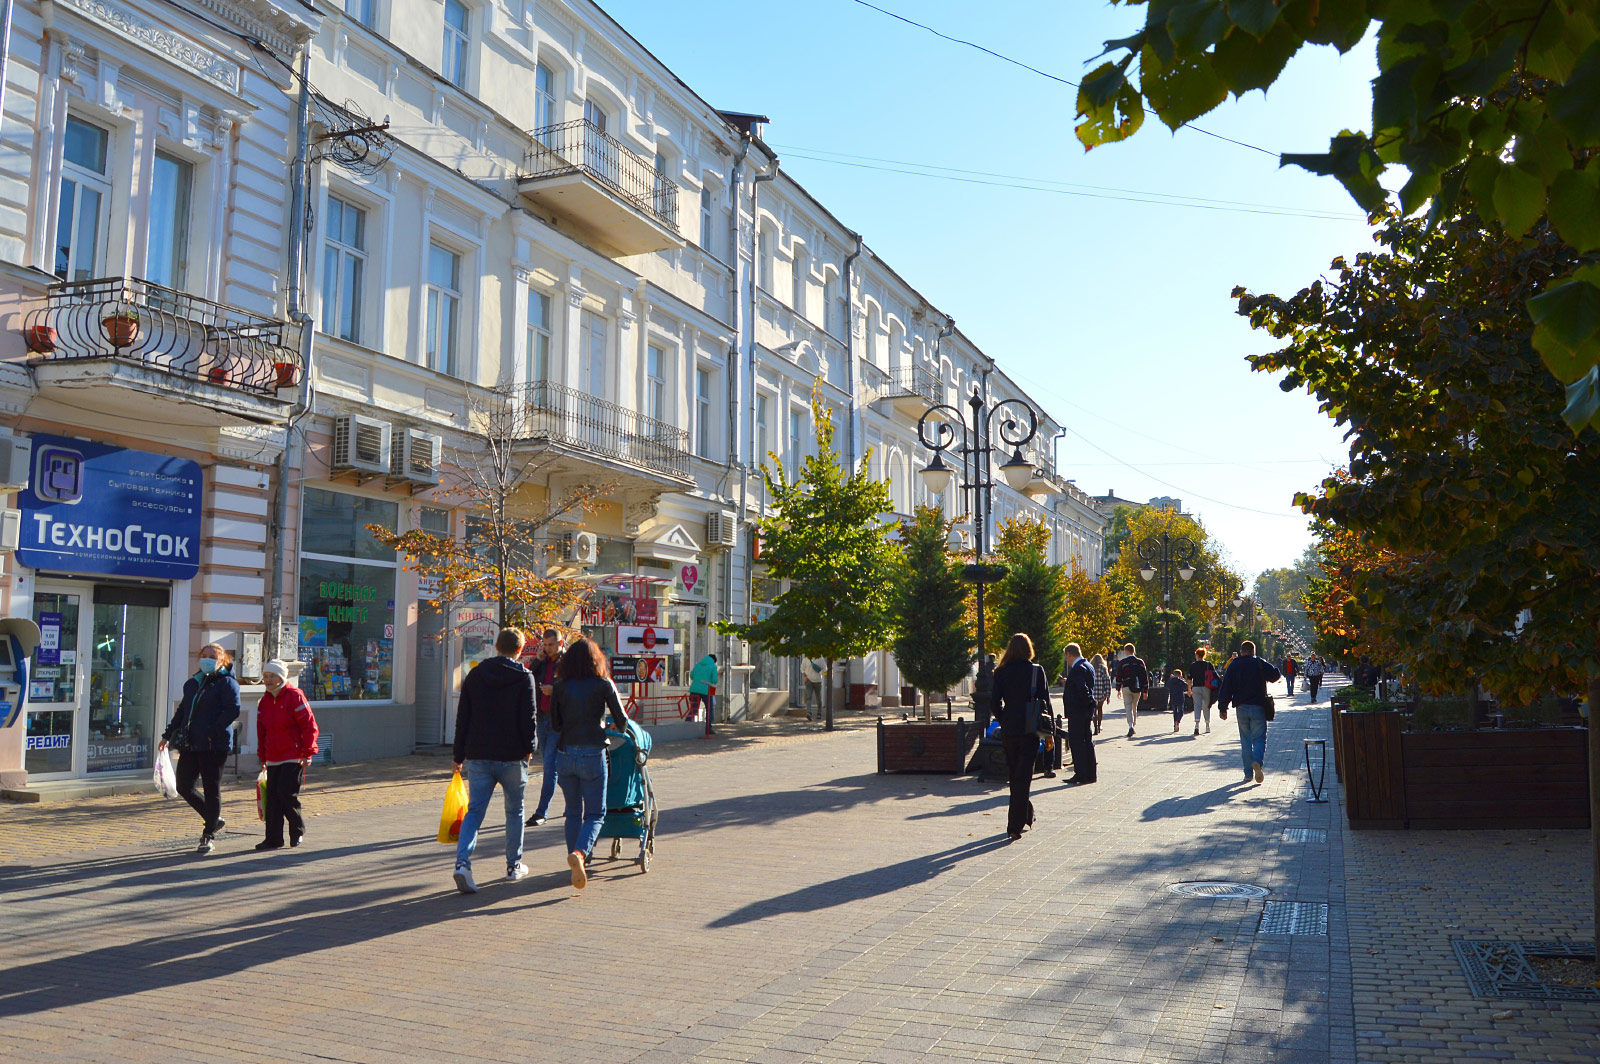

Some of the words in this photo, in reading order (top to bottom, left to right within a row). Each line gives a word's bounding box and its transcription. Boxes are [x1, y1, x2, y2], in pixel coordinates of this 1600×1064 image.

[129, 469, 187, 484] электроника
[108, 480, 149, 491] бытовая
[151, 487, 186, 498] техника
[132, 500, 186, 513] аксессуары
[320, 581, 376, 601] ВОЕННАЯ
[328, 605, 368, 623] КНИГА
[458, 612, 493, 621] КНИГИ
[26, 735, 70, 749] РЕДИТ
